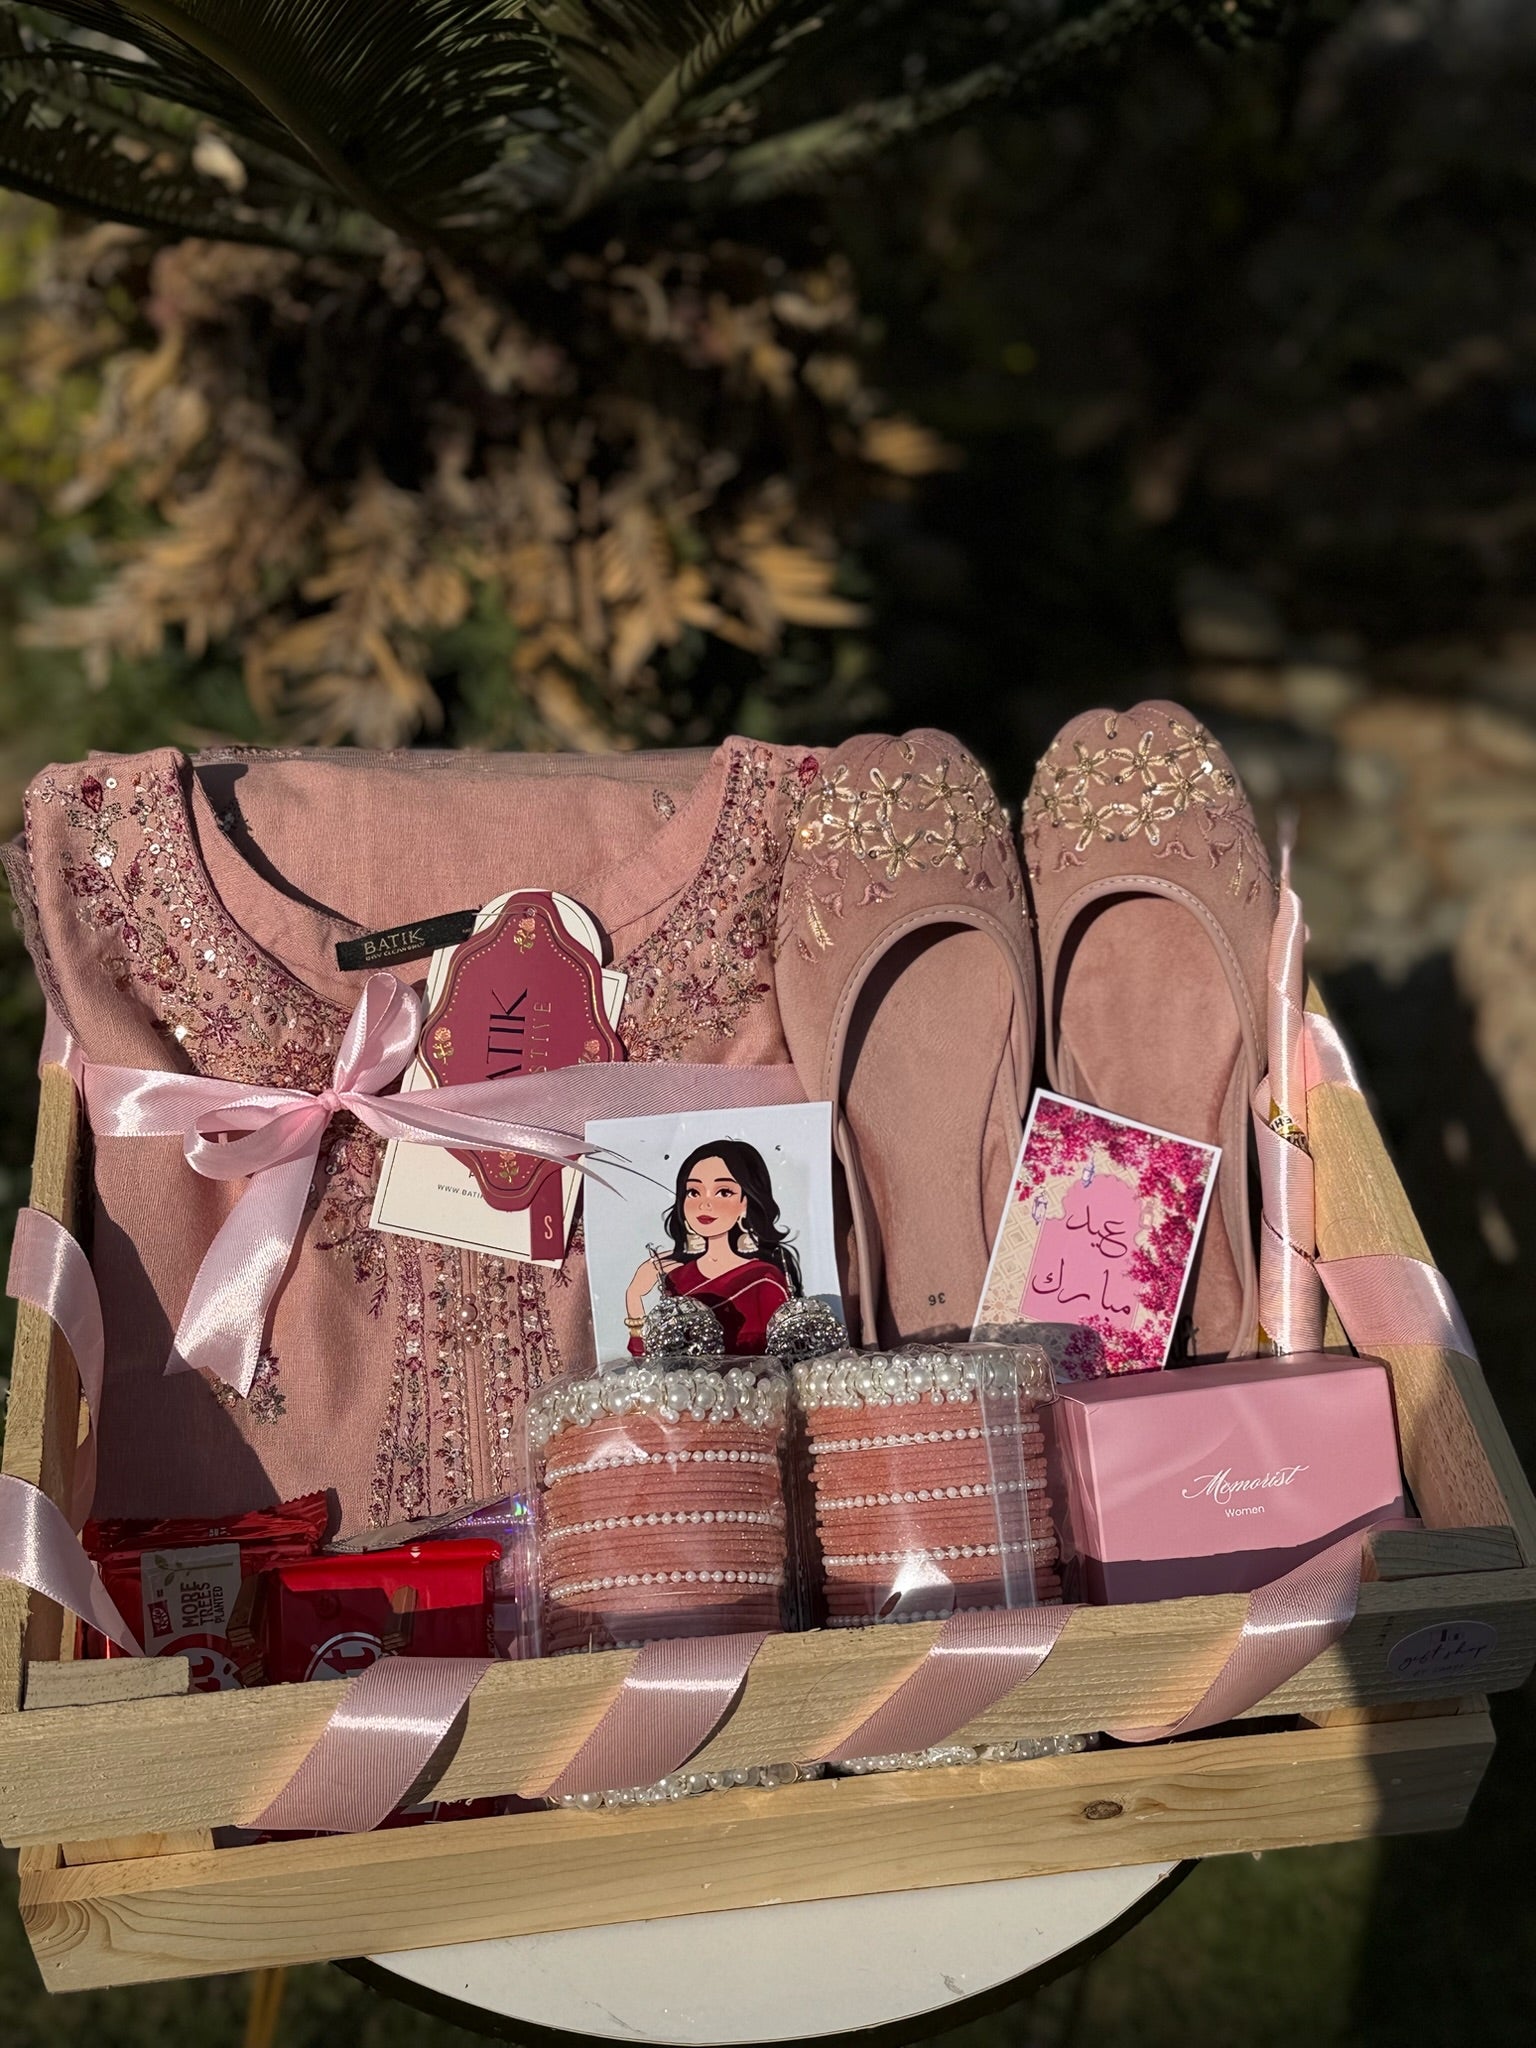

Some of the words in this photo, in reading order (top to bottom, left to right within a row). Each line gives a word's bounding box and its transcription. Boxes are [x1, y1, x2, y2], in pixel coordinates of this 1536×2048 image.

[364, 928, 425, 956] BATIK
[485, 988, 528, 1081] ATIK
[543, 1215, 553, 1240] S
[1065, 1204, 1128, 1258] عيد
[928, 1292, 946, 1306] 36
[1031, 1258, 1132, 1321] مبارك
[1181, 1465, 1310, 1505] Memorist
[1224, 1505, 1265, 1518] Women
[180, 1581, 200, 1628] MORE
[197, 1582, 214, 1626] TREES
[212, 1586, 225, 1623] PLANTED
